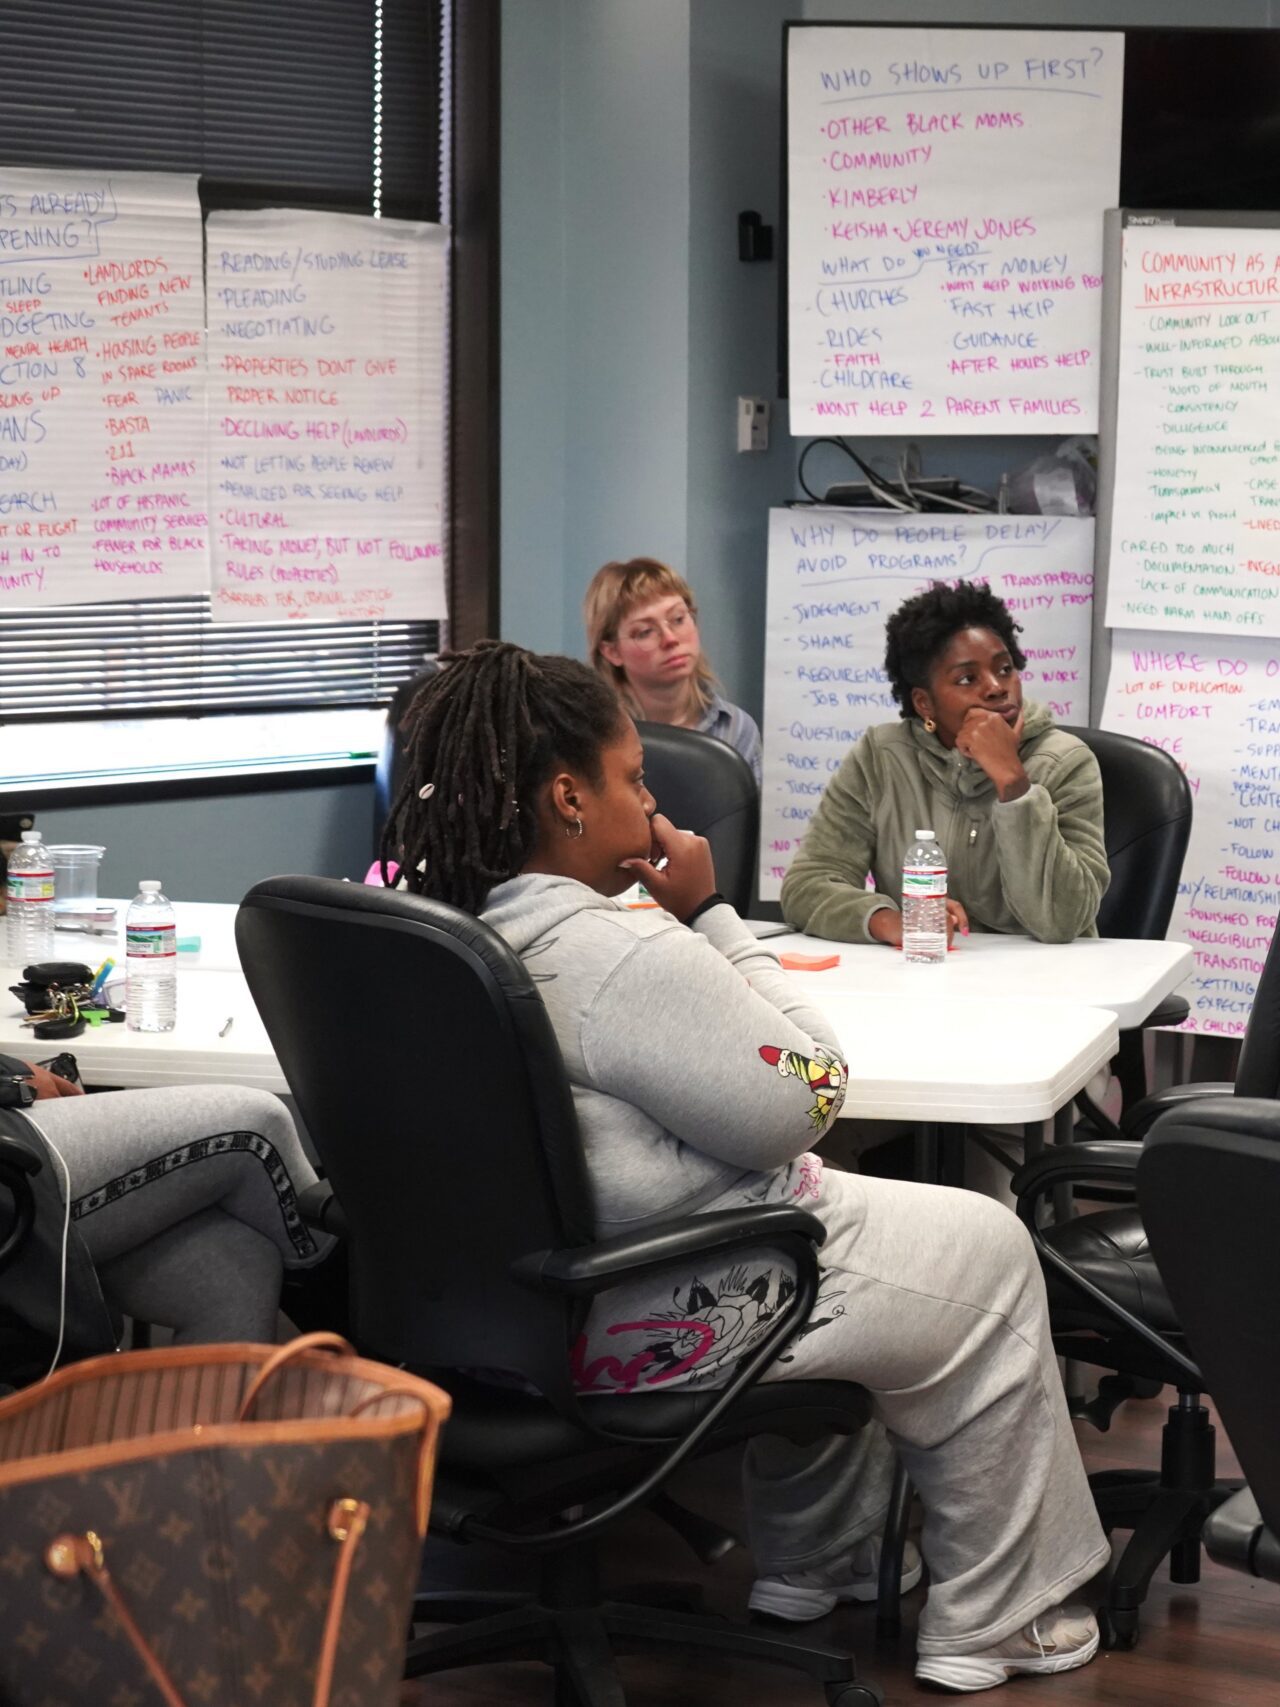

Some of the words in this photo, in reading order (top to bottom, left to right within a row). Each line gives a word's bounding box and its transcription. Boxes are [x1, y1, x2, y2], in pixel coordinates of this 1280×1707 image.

[820, 69, 871, 92] WHO
[889, 62, 962, 86] SHOWS
[979, 62, 1008, 80] UP
[1026, 47, 1103, 81] FIRST?
[827, 116, 891, 140] OTHER
[907, 113, 963, 135] BLACK
[976, 112, 1024, 129] MOMS
[831, 146, 932, 171] COMMUNITY
[830, 185, 917, 209] KIMBERLY
[900, 217, 969, 242] JEREMY
[974, 217, 1037, 241] JONES
[822, 256, 870, 275] WHAT
[883, 256, 906, 271] DO
[1001, 254, 1068, 275] MONEY
[1142, 251, 1236, 274] COMMUNITY
[1246, 253, 1264, 273] AS
[1008, 299, 1054, 319] HELP
[954, 332, 1038, 350] GUIDANCE
[1056, 351, 1091, 369] HELP
[870, 400, 908, 417] HELP
[921, 400, 936, 417] 2
[946, 396, 1001, 416] PARENT
[1012, 398, 1082, 416] FAMILIES
[790, 524, 835, 548] WHY
[853, 527, 879, 547] DO
[895, 526, 967, 544] PEOPLE
[797, 554, 847, 575] AVOID
[868, 544, 968, 570] PROGRAMS?
[1194, 585, 1279, 600] COMMUNICATION
[797, 633, 854, 649] SHAME
[1133, 651, 1208, 672] WHERE
[1218, 658, 1248, 677] DO
[1126, 681, 1146, 694] LOT
[1150, 681, 1165, 691] OF
[1172, 680, 1243, 694] DUPLICATION
[1137, 704, 1212, 720] COMFORT
[1234, 818, 1256, 831] NOT
